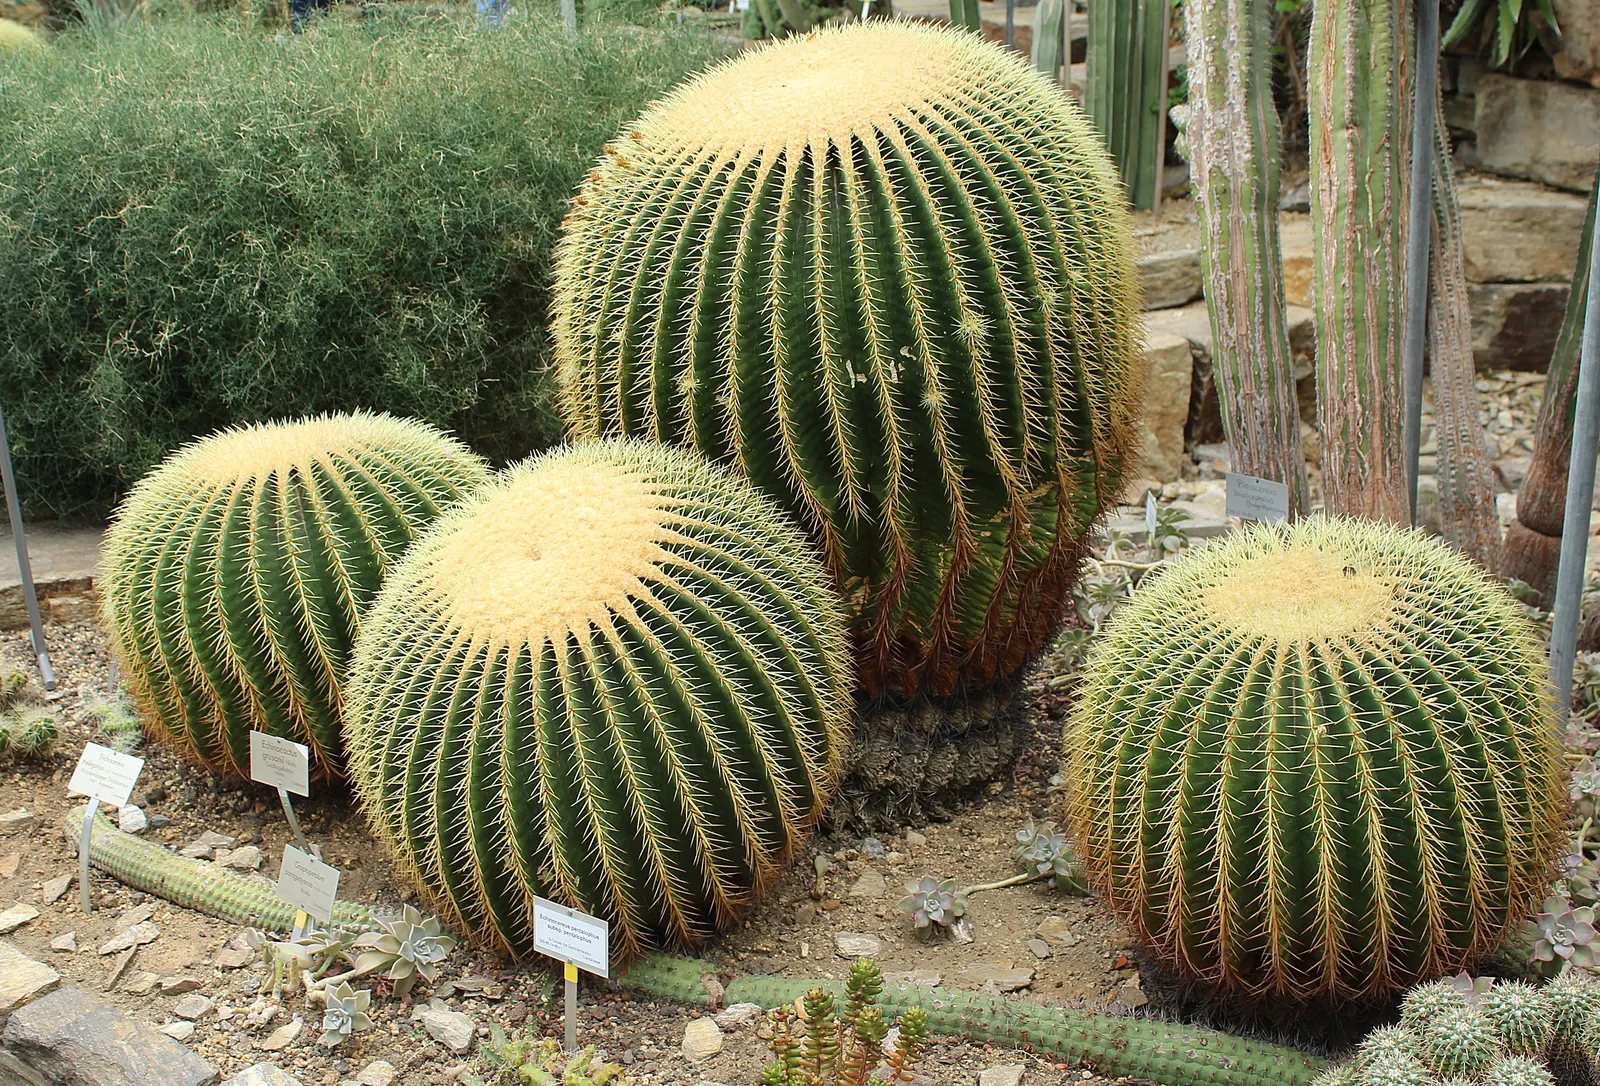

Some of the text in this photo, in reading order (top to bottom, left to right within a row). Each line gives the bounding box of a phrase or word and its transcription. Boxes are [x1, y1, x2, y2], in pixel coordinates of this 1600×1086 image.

[539, 913, 600, 940] Echinocereus pentalophus
[563, 930, 592, 944] pentalophus
